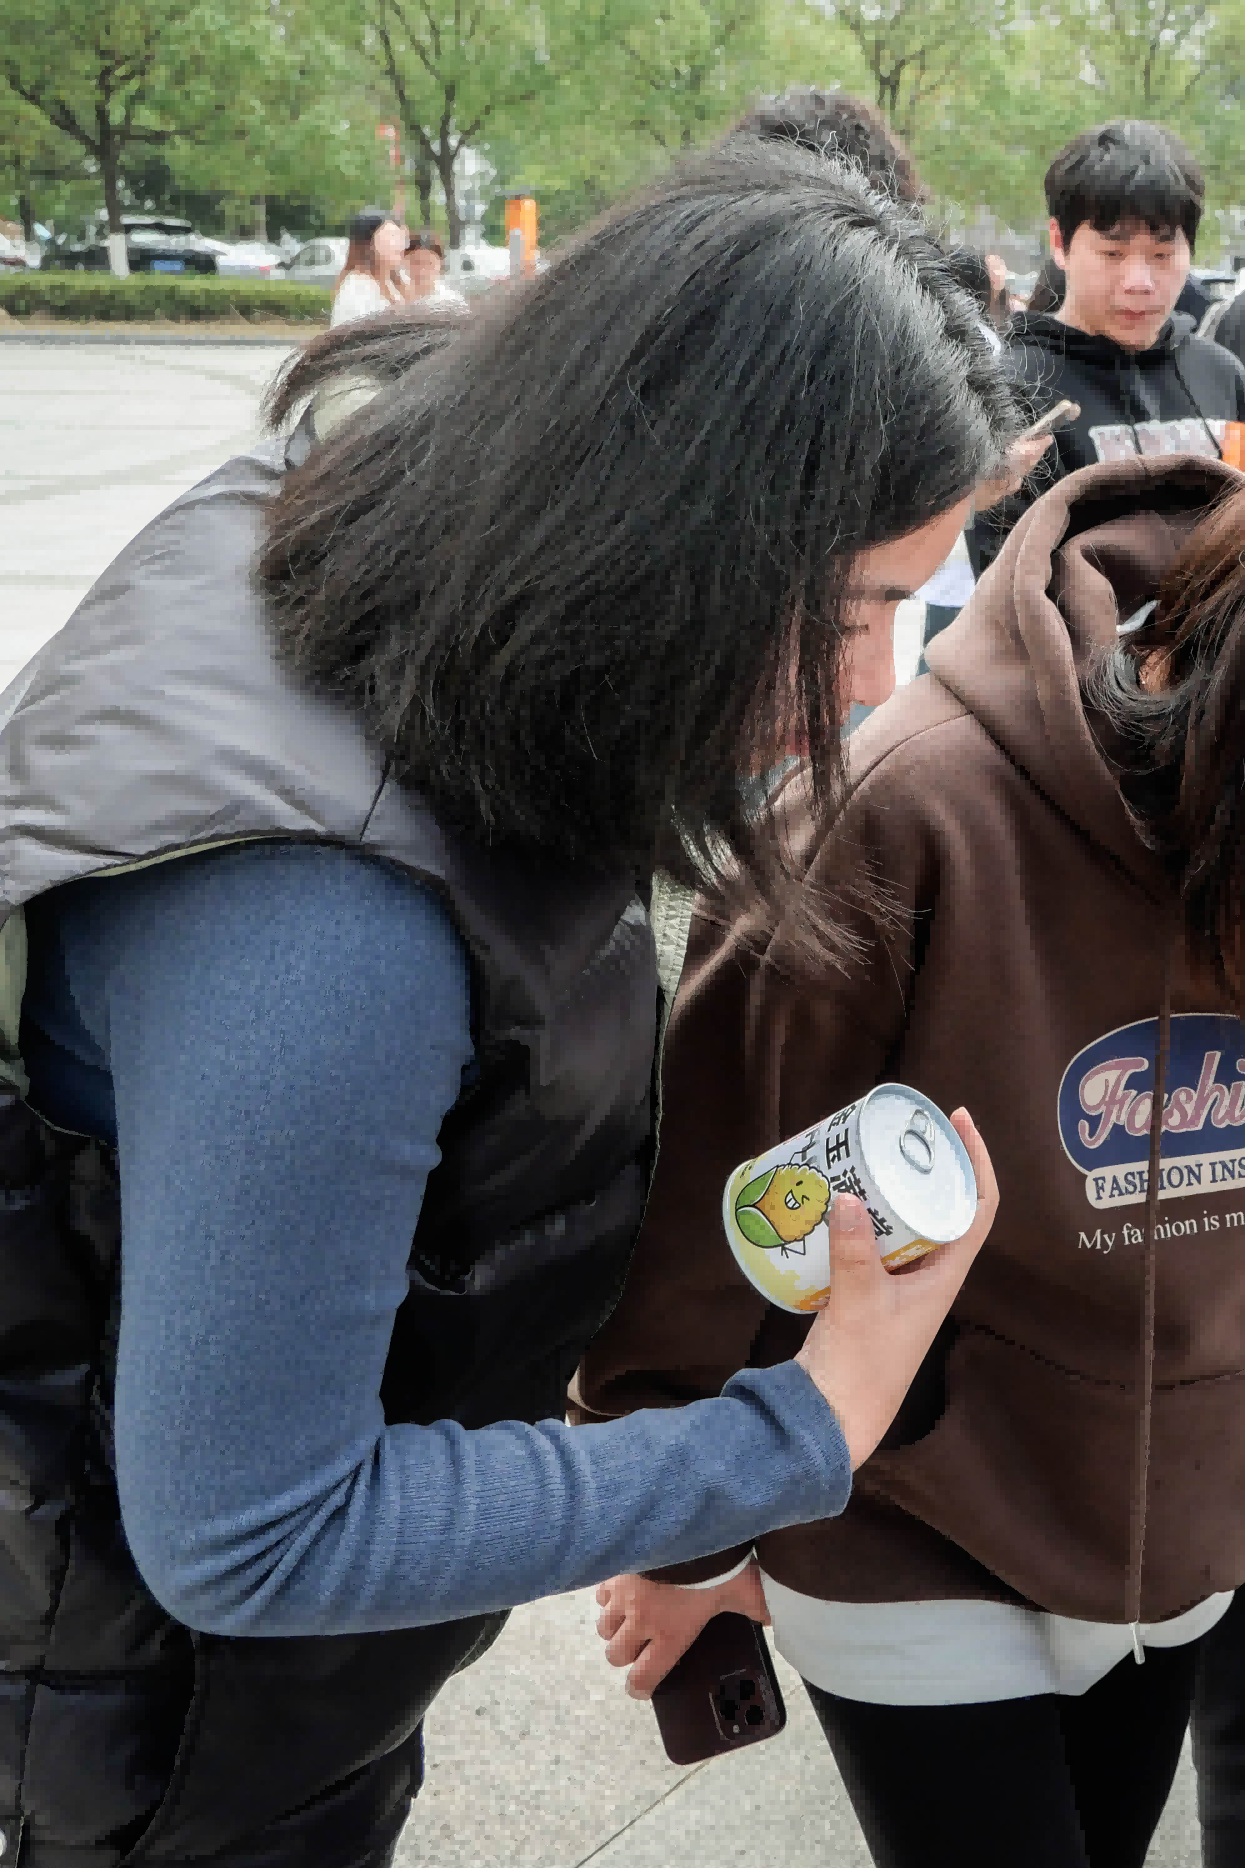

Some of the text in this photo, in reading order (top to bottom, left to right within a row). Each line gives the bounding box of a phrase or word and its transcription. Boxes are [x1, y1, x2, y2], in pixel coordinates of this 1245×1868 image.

[1077, 1228, 1116, 1254] My
[1122, 1216, 1199, 1244] fahion
[1202, 1210, 1221, 1233] is
